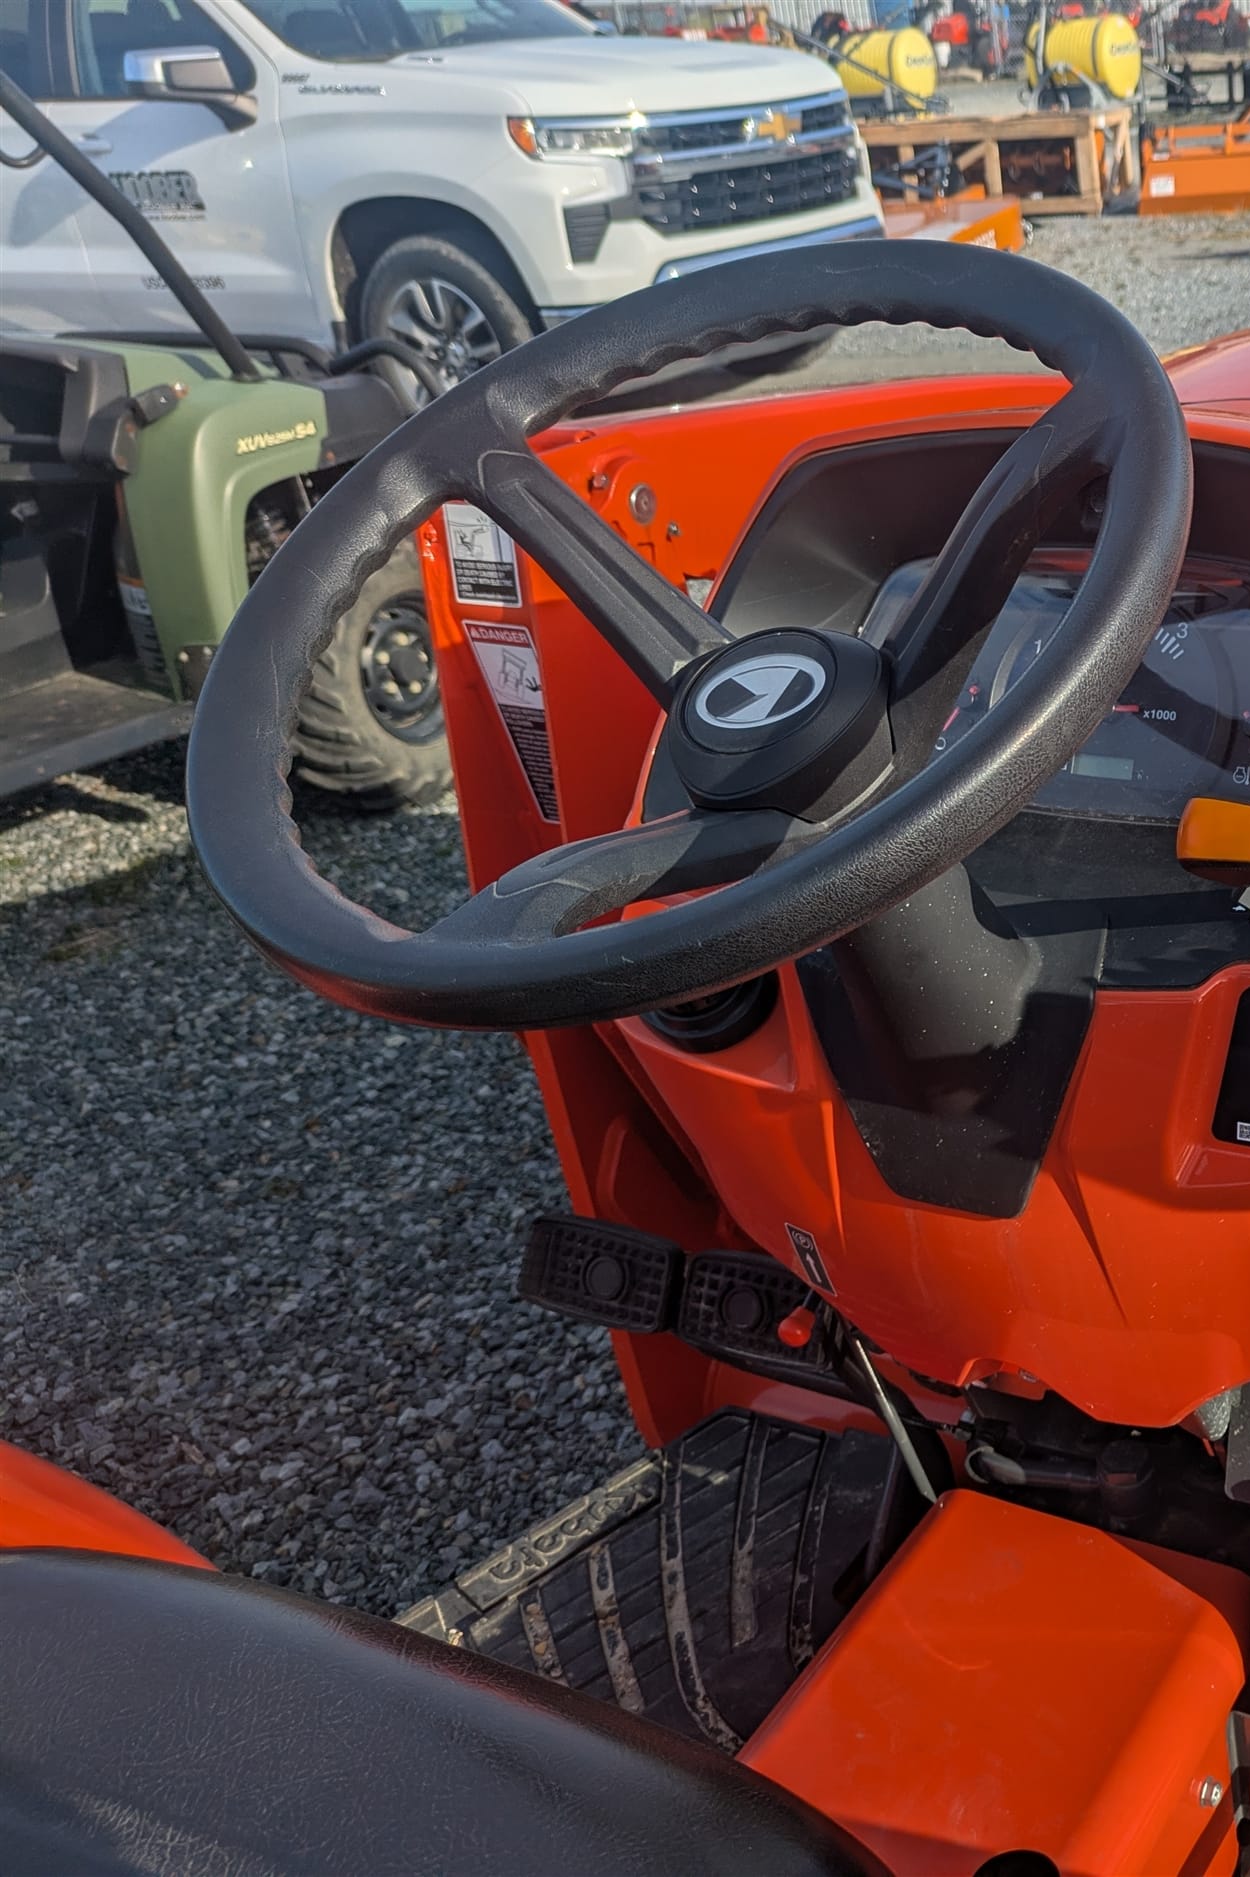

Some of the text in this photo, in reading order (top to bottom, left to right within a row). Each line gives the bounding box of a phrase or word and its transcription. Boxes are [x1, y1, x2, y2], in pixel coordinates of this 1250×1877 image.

[479, 626, 527, 644] DANGER
[1177, 622, 1189, 639] 3
[1143, 709, 1177, 722] x1000
